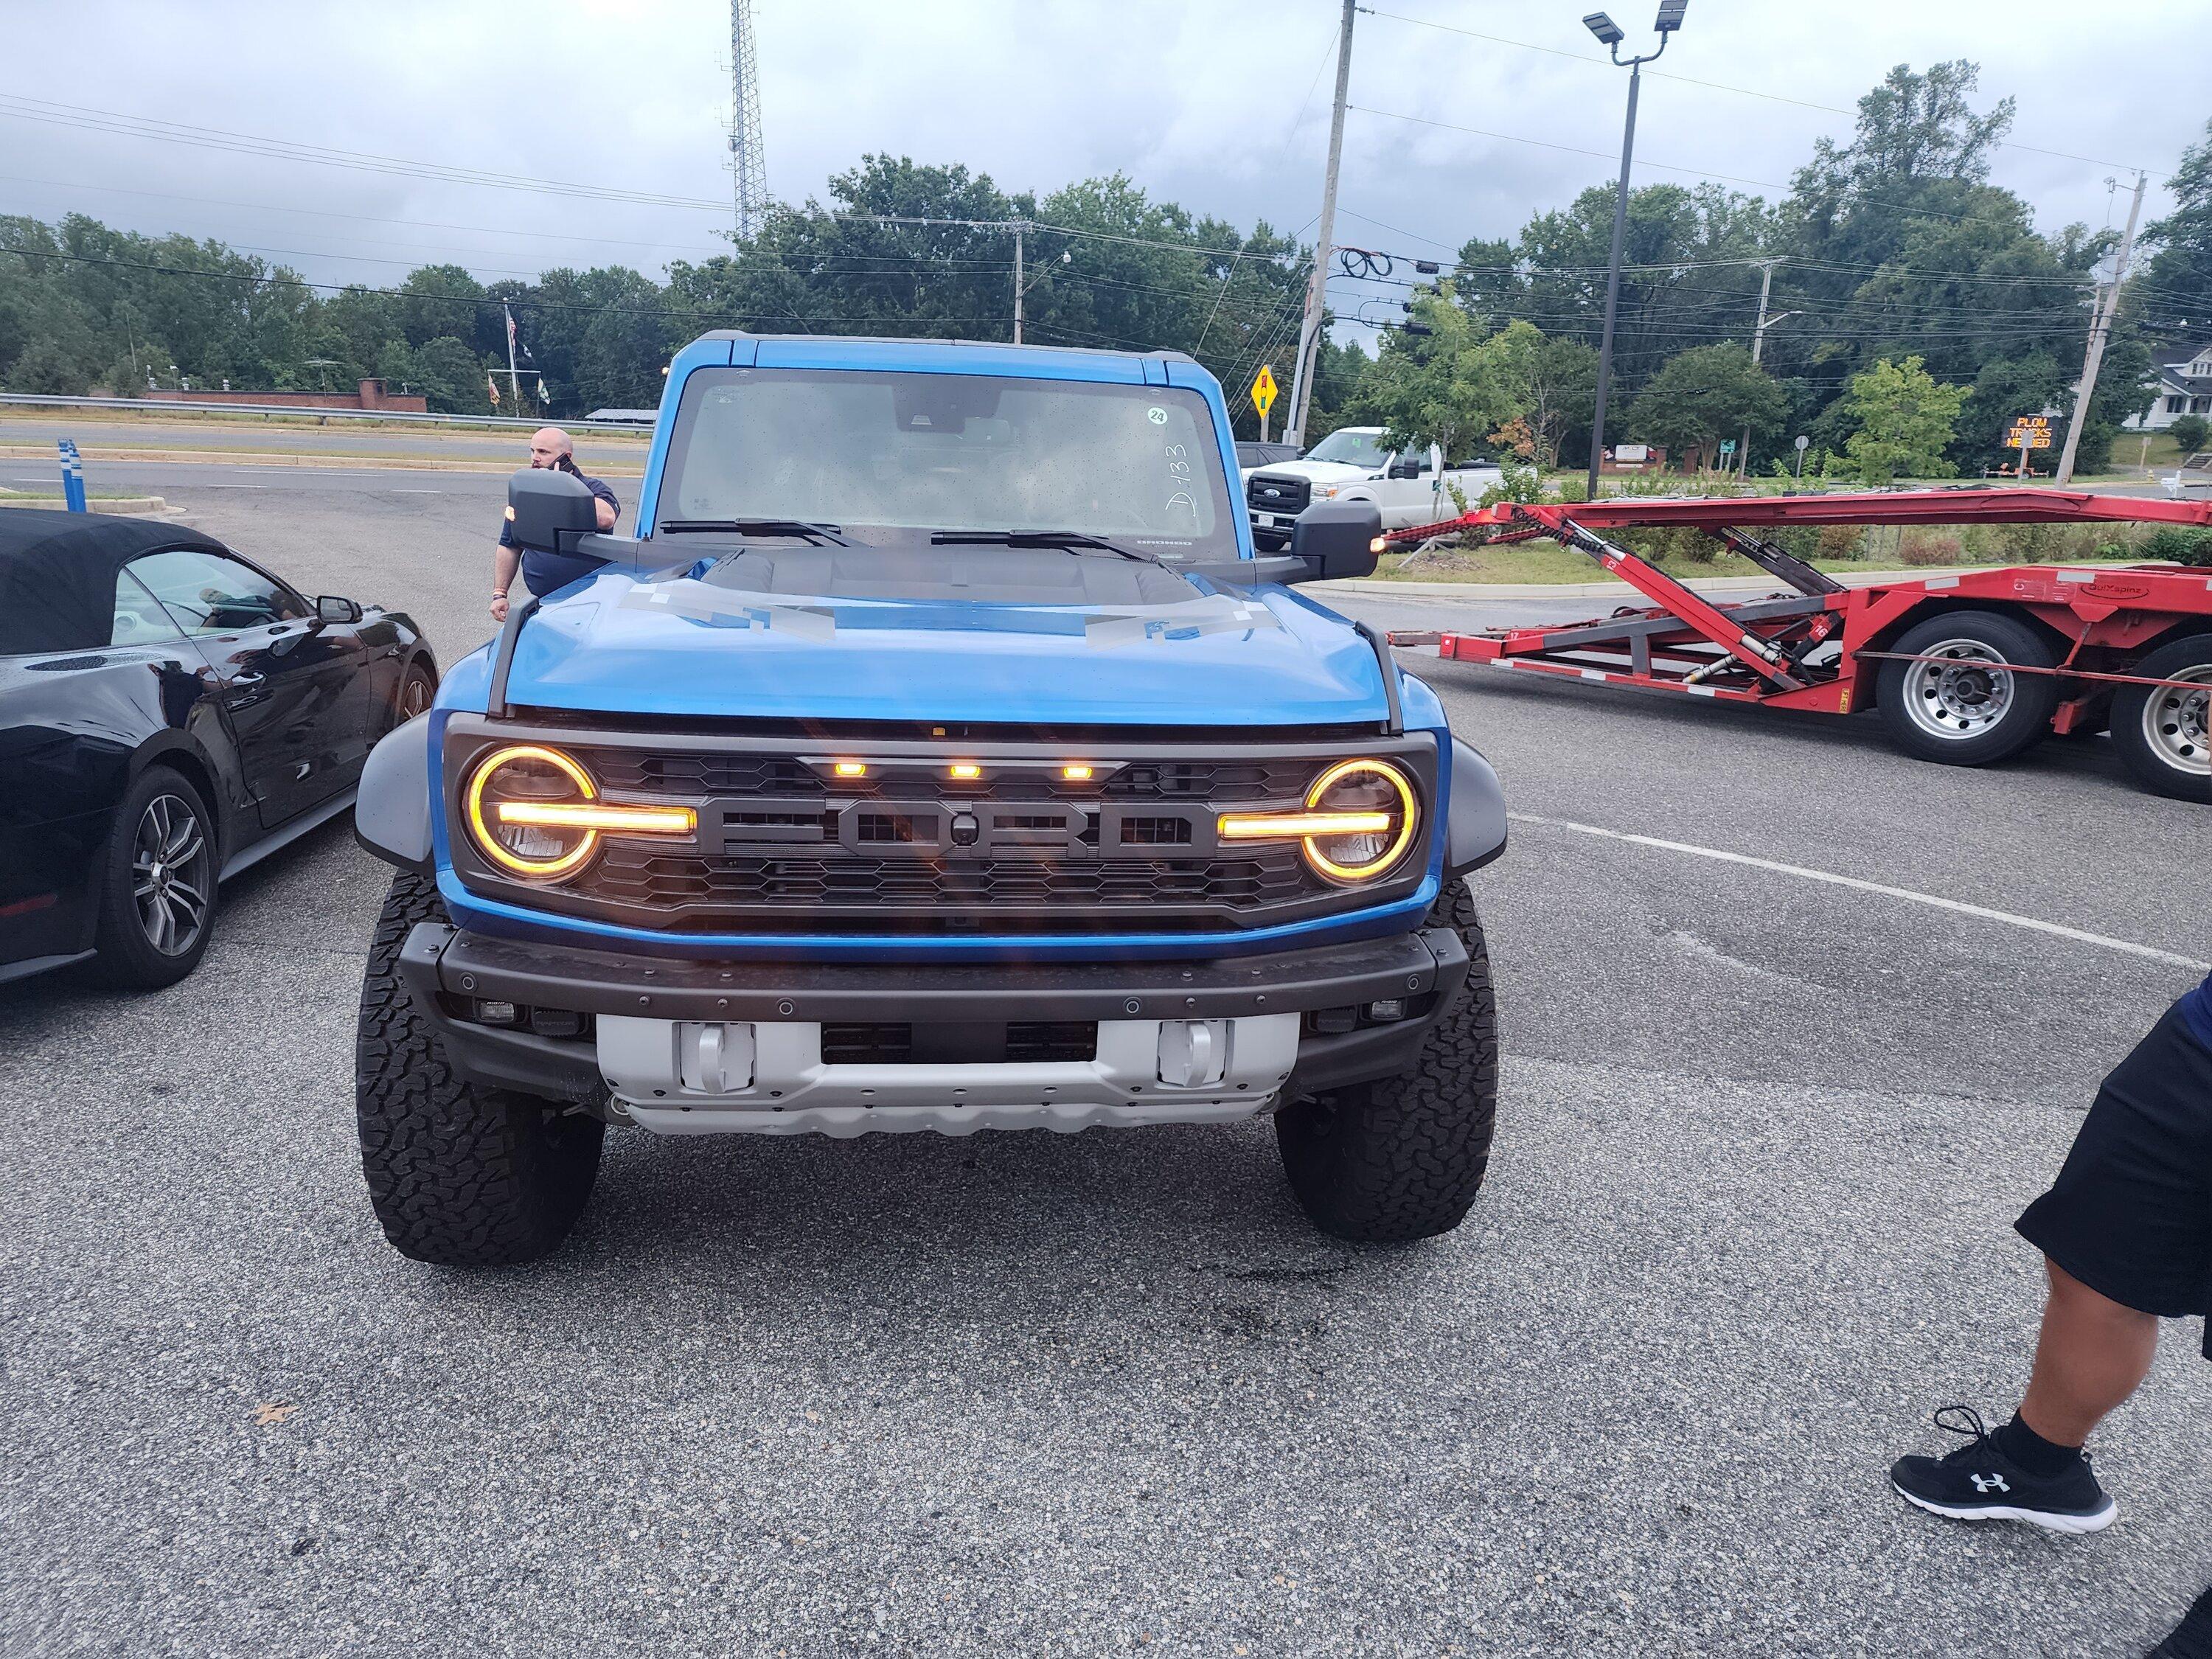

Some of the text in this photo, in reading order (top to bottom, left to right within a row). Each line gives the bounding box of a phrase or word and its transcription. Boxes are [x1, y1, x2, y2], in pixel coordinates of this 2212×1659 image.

[1150, 410, 1164, 422] 24
[2017, 417, 2048, 428] PLOW
[1606, 560, 1617, 571] 13
[1510, 632, 1520, 640] 17
[1815, 625, 1829, 638] 16
[700, 797, 1216, 859] FORD
